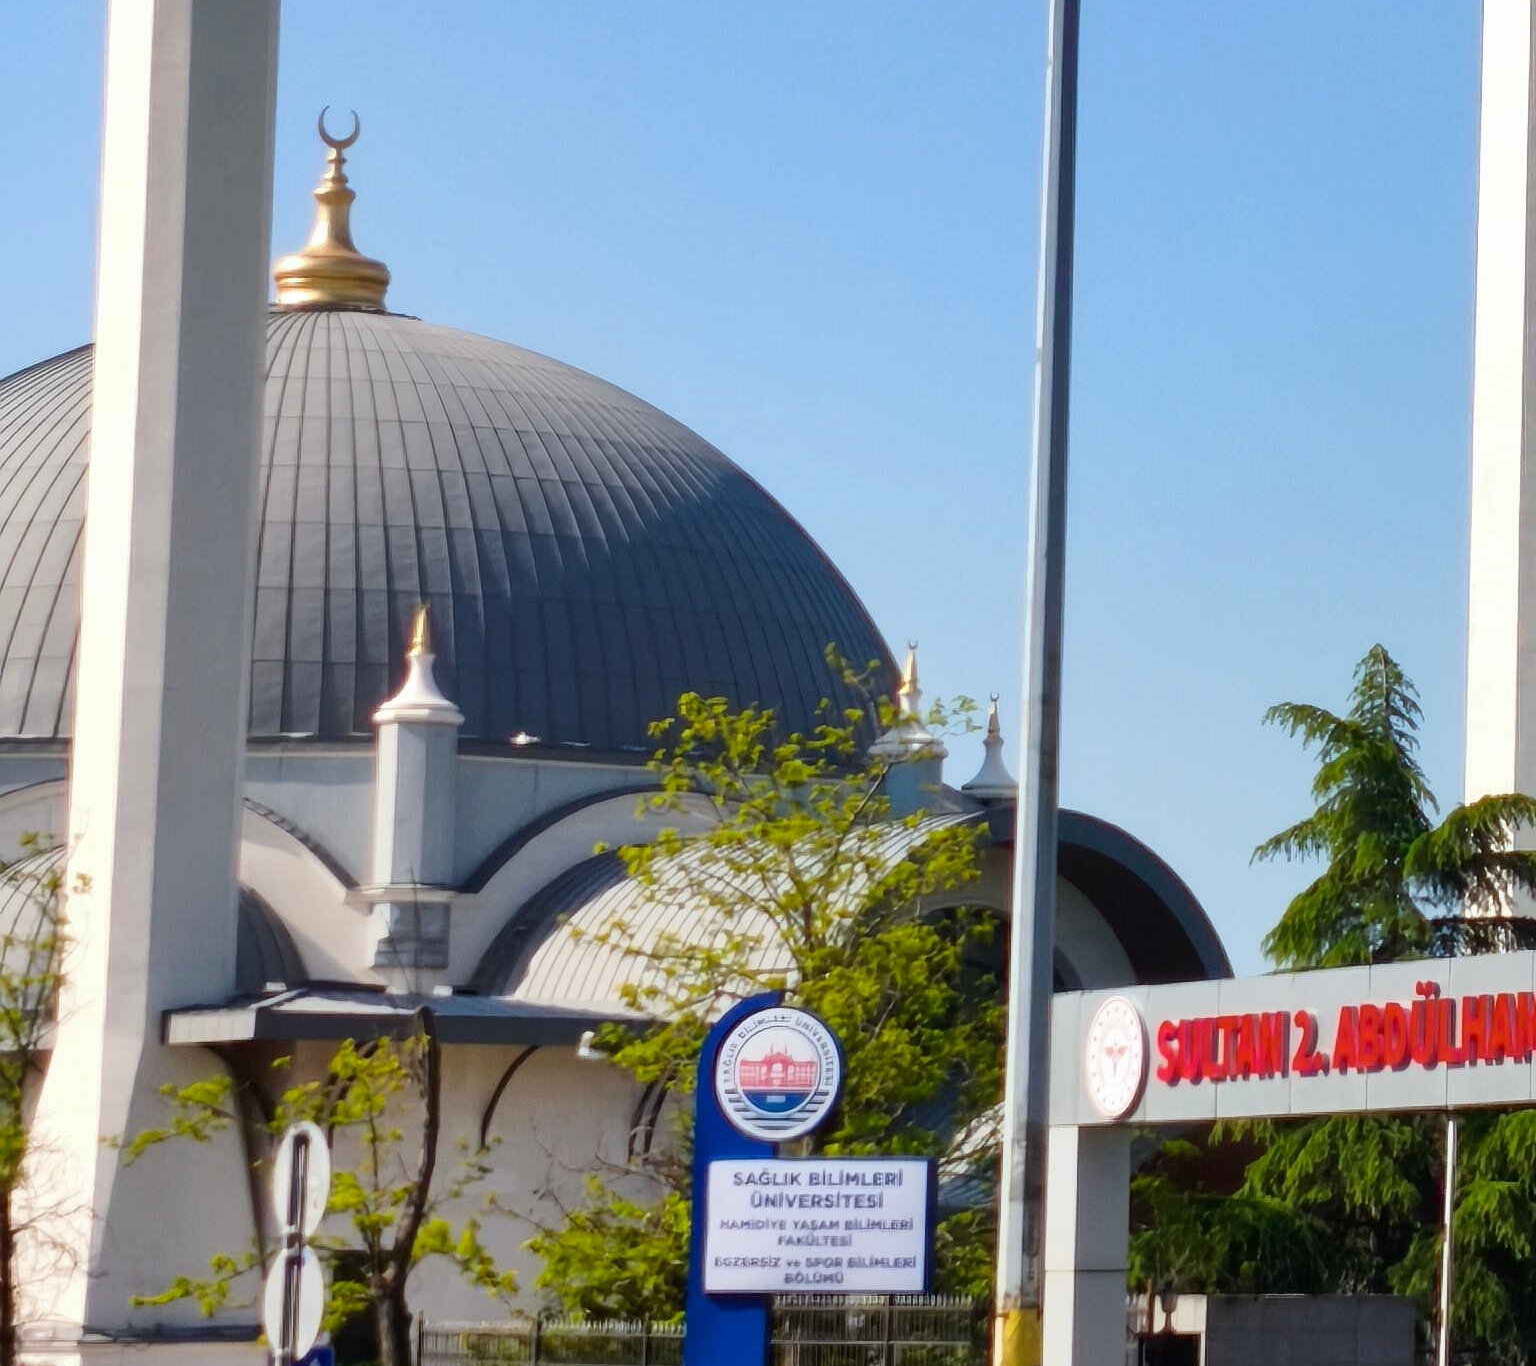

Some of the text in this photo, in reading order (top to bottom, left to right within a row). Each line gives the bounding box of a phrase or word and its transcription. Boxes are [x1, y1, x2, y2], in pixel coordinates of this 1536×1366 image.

[1156, 1010, 1291, 1085] SULTAN
[1293, 1008, 1330, 1077] 2.
[733, 1168, 904, 1187] SAĞLIK BİLİMLERİ
[750, 1190, 884, 1209] ÜNİVERSİTESİ
[720, 1218, 914, 1232] HAMİDİYE YAŞAM BİLİMLERİ
[778, 1233, 852, 1247] FAKÜLTESİ
[714, 1256, 782, 1268] EGZERSİZ
[805, 1258, 842, 1269] SPOR
[847, 1256, 917, 1269] BİLİMLERİ
[784, 1272, 844, 1285] BÖLÜMÜ
